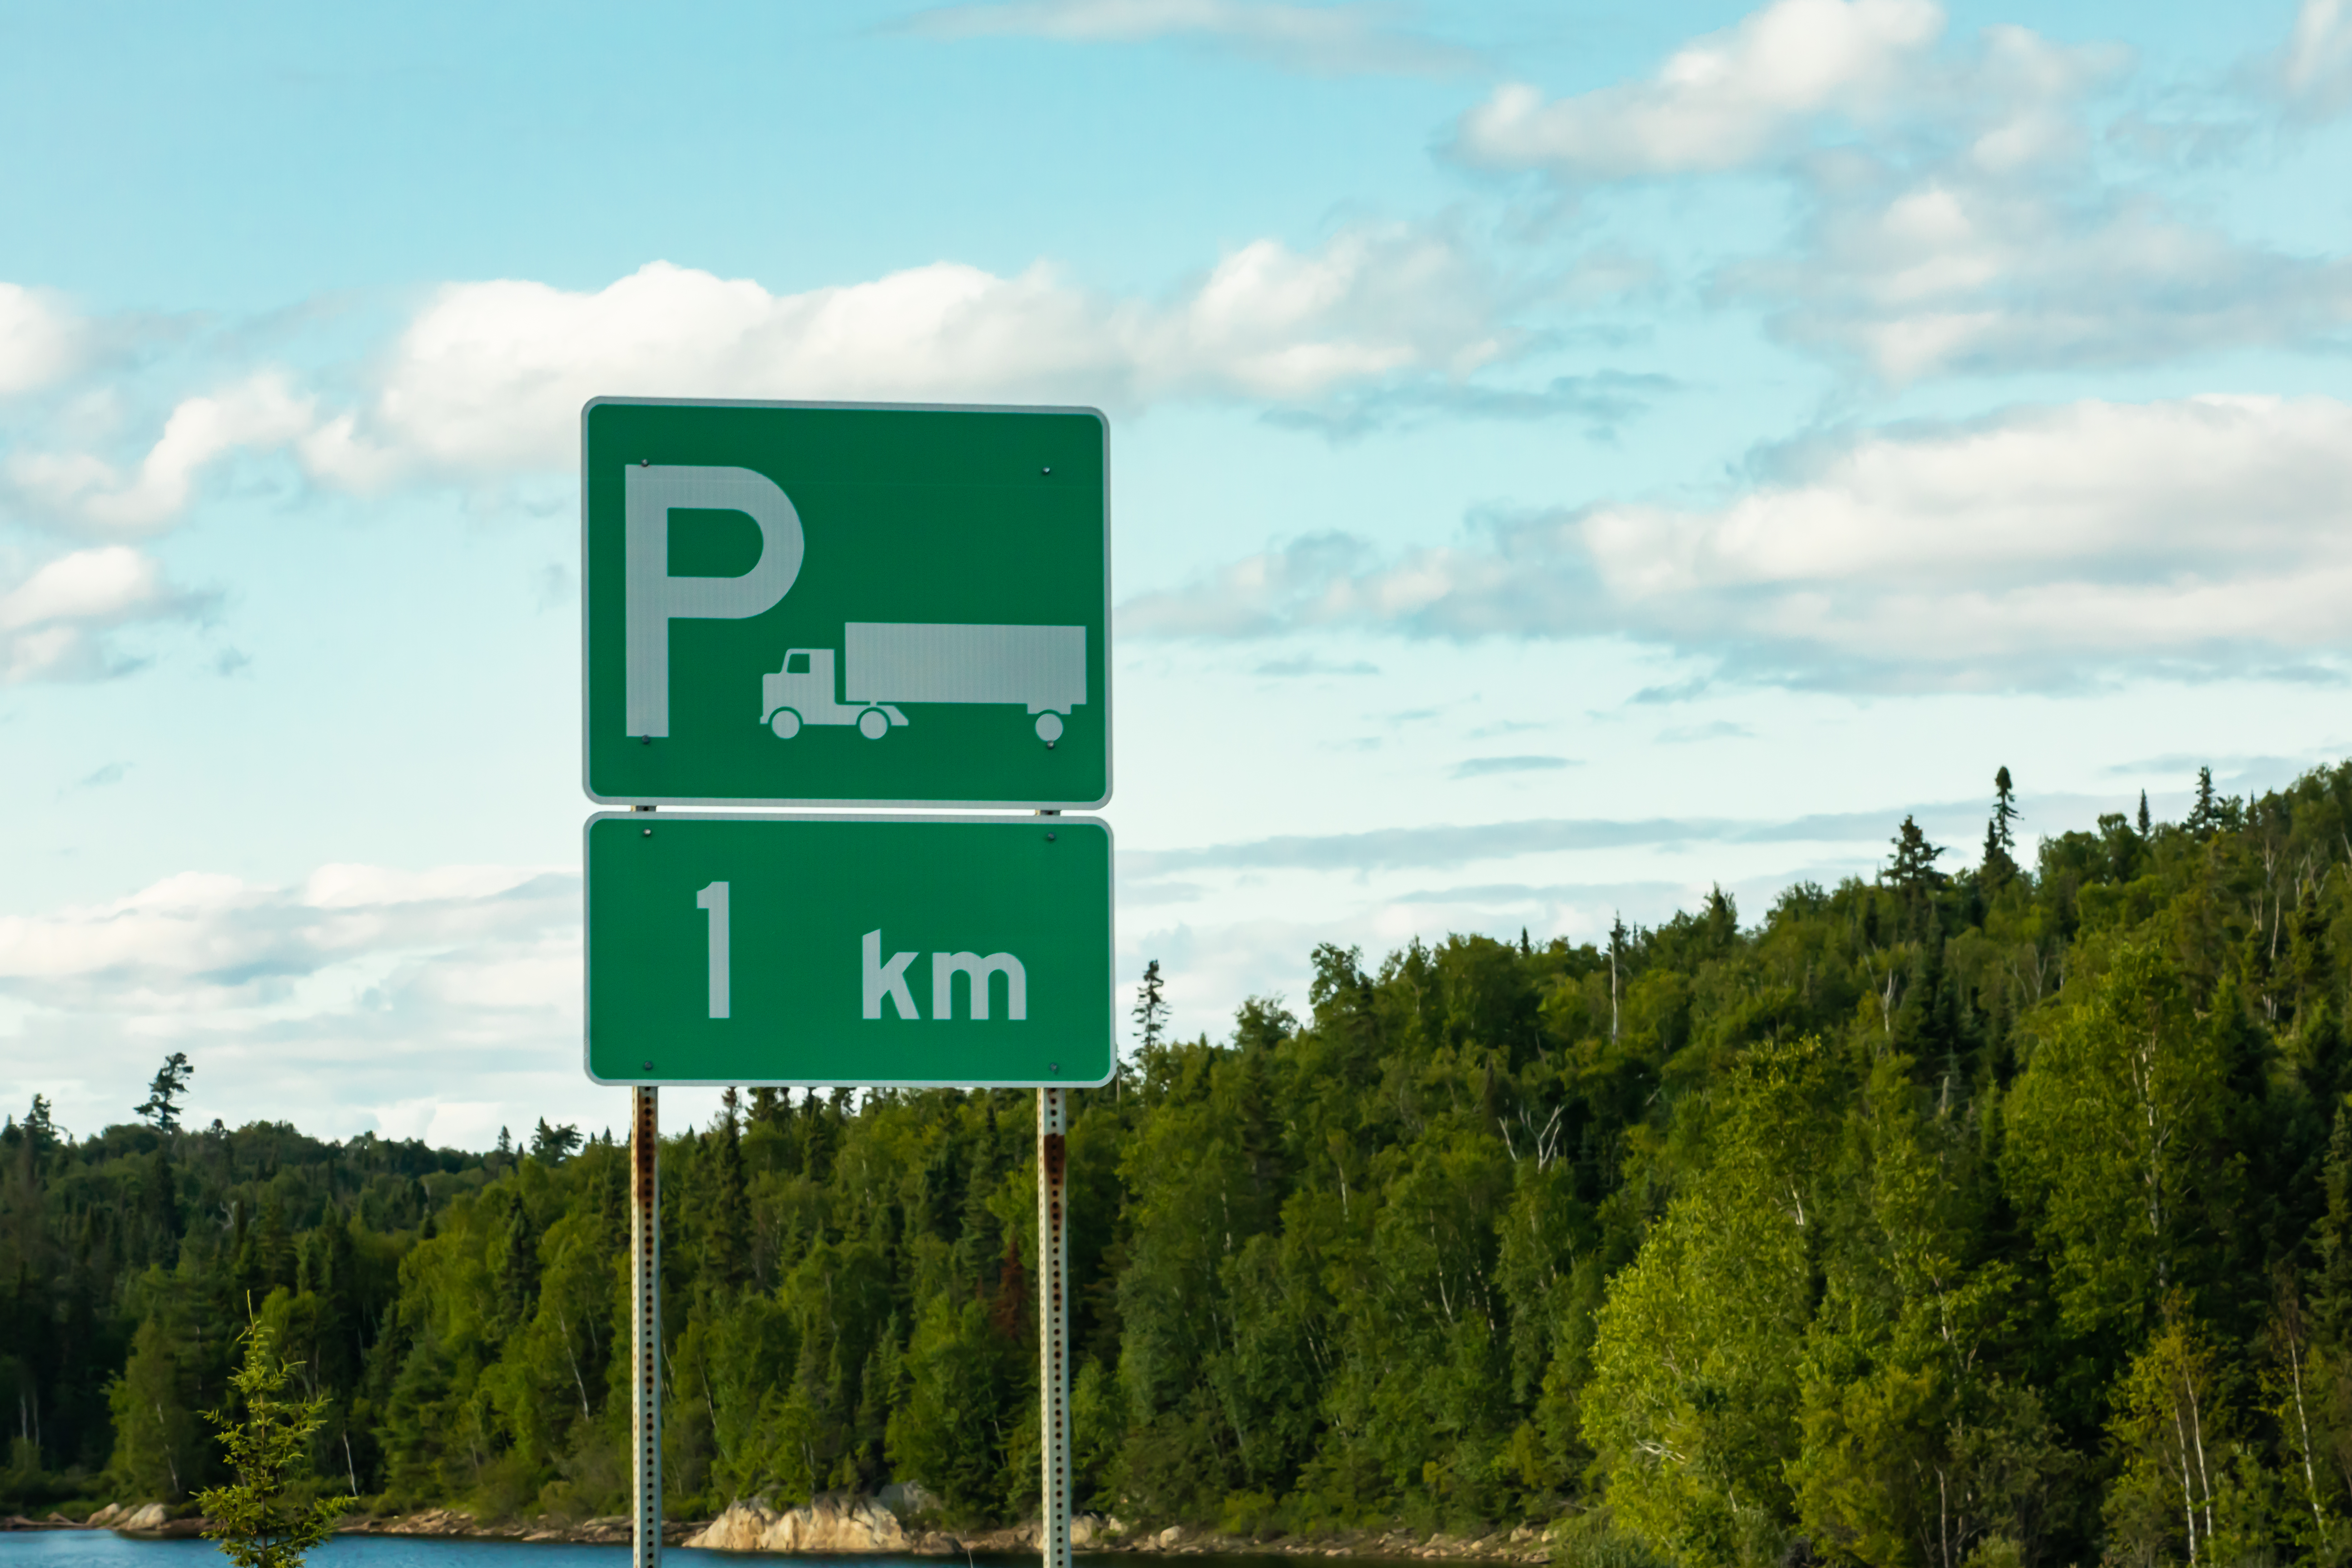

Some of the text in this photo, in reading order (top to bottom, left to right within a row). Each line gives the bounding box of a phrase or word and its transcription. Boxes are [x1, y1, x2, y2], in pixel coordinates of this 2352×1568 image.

[625, 464, 804, 737] P
[697, 881, 1026, 1020] 1 km
